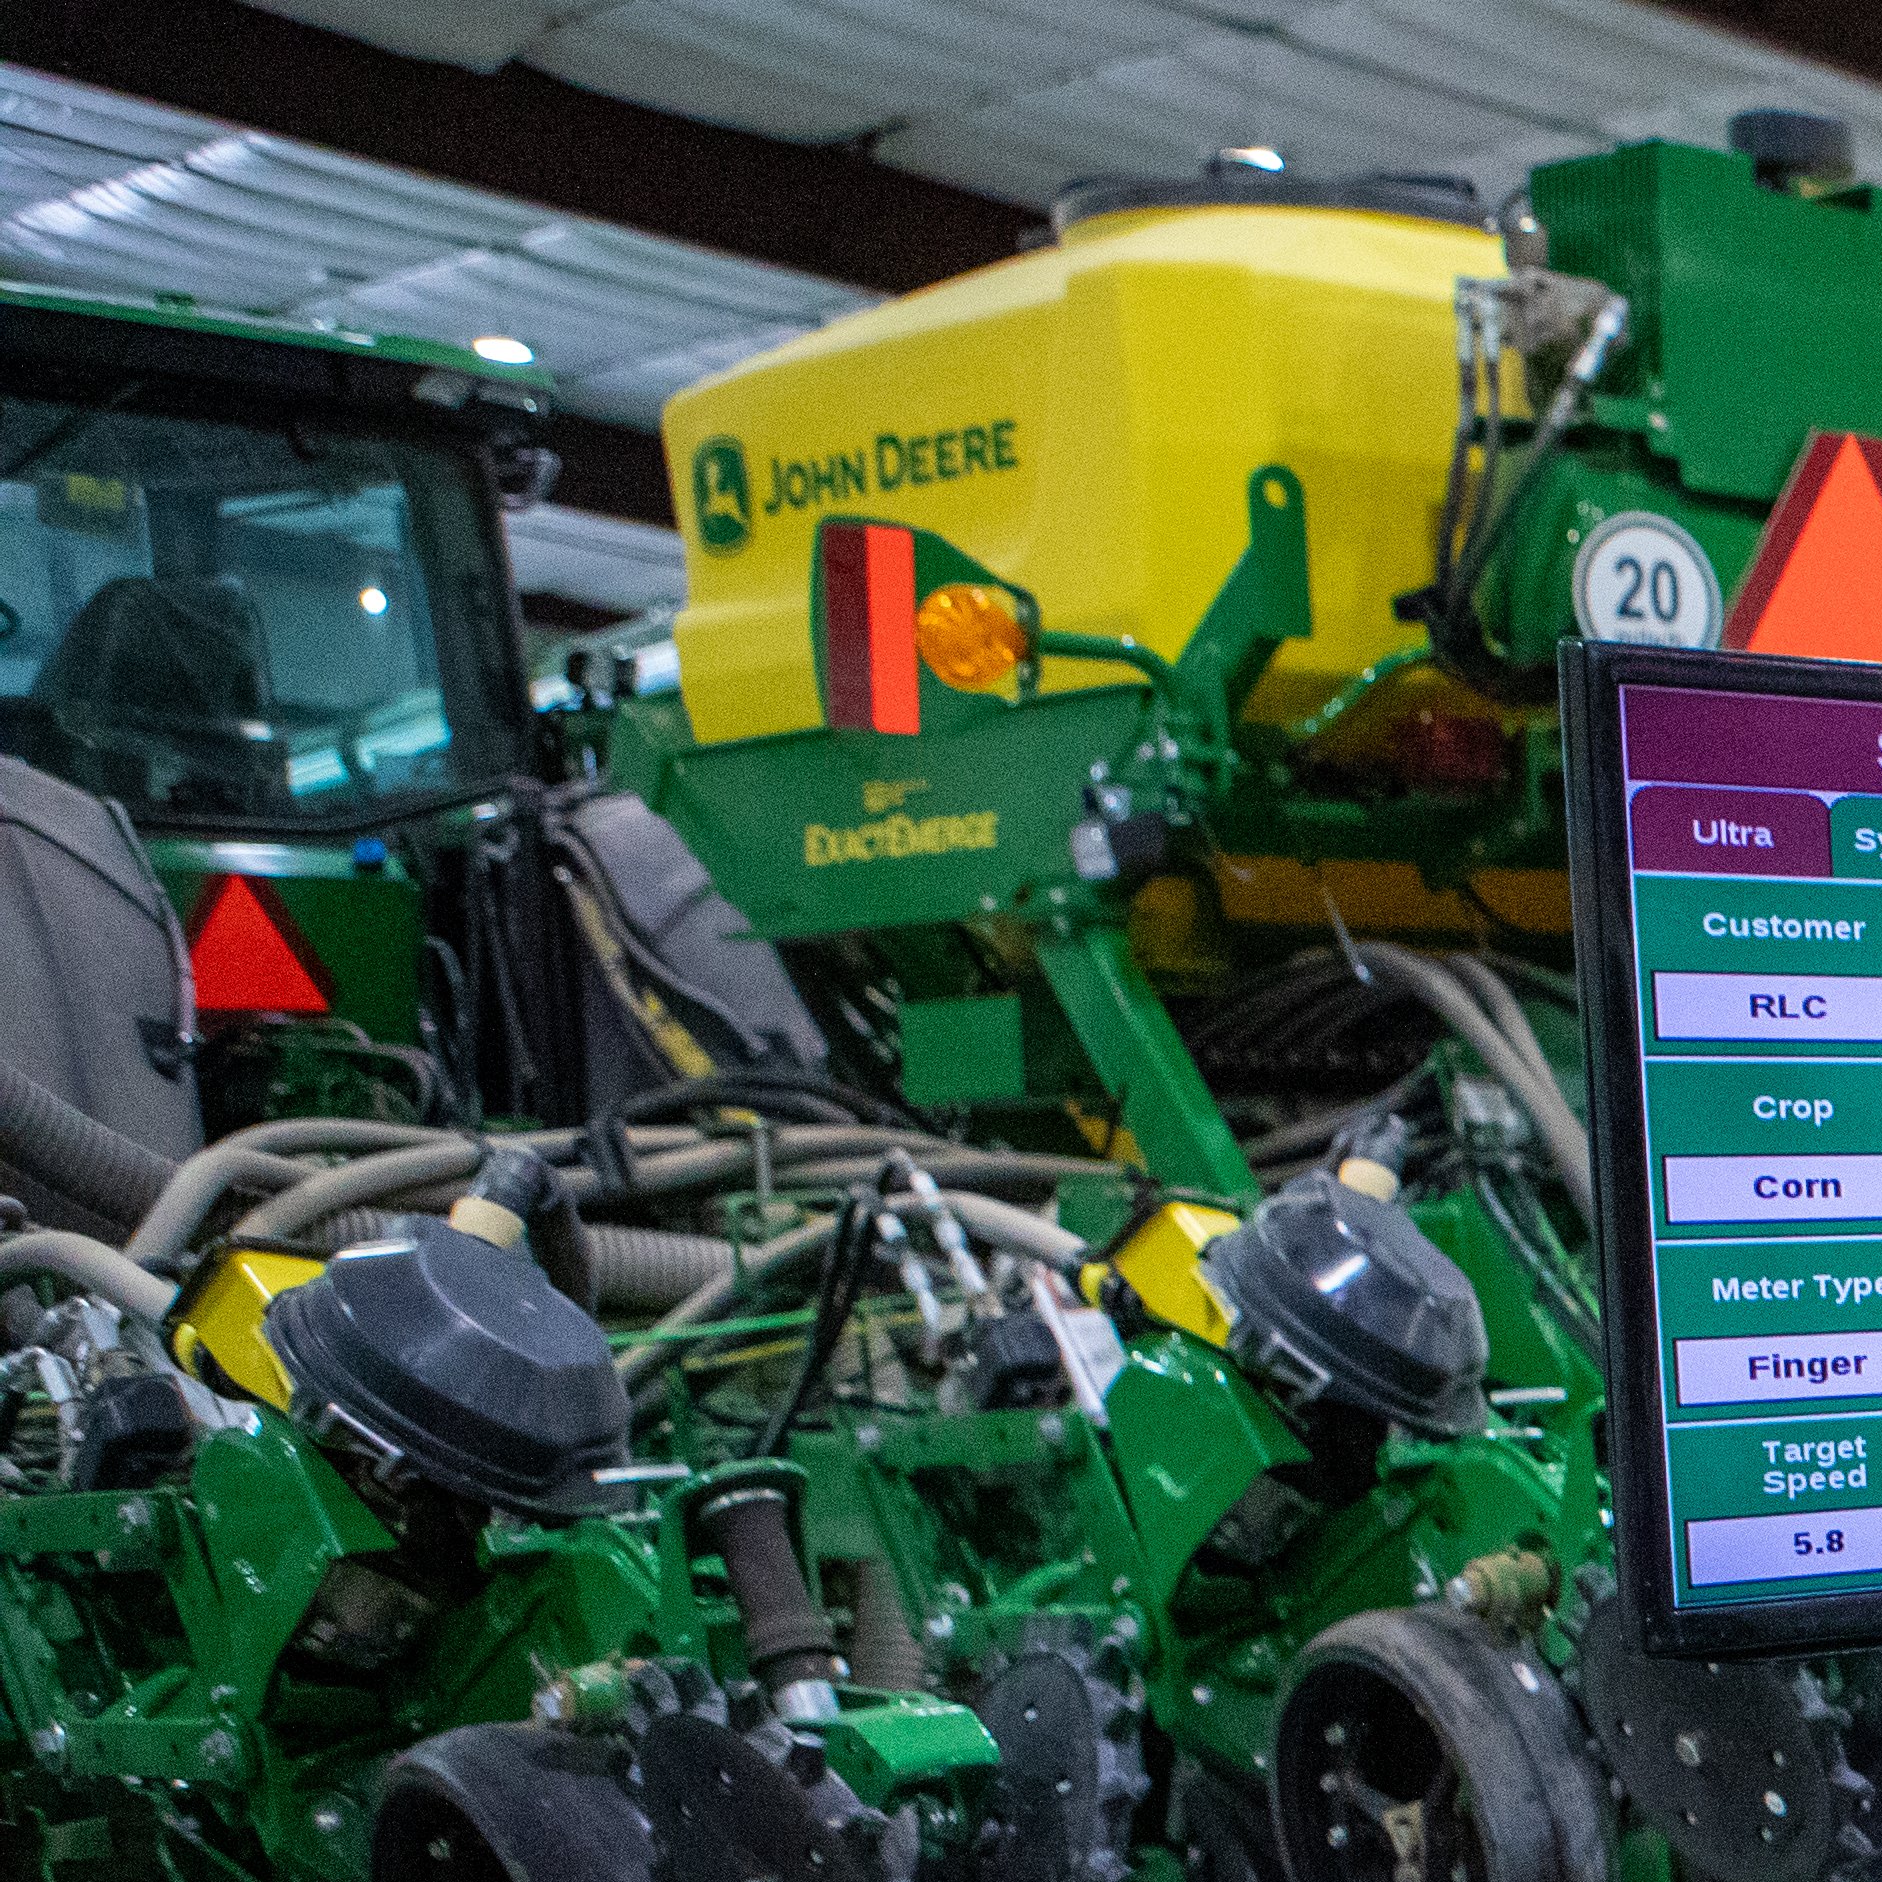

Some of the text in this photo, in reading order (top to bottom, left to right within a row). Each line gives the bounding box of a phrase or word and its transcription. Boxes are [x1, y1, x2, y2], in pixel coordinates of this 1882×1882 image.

[763, 421, 1018, 516] JOHN DEERE
[1614, 555, 1680, 624] 20
[1693, 819, 1774, 848] Ultra
[1703, 913, 1865, 941] Customer
[1750, 994, 1827, 1019] RLC
[1754, 1096, 1833, 1127] Crop
[1753, 1174, 1841, 1200] Corn
[1712, 1275, 1803, 1301] Meter
[1748, 1353, 1867, 1384] Finger
[1763, 1435, 1867, 1469] Target
[1763, 1464, 1868, 1499] Speed
[1793, 1531, 1844, 1555] 5.8
